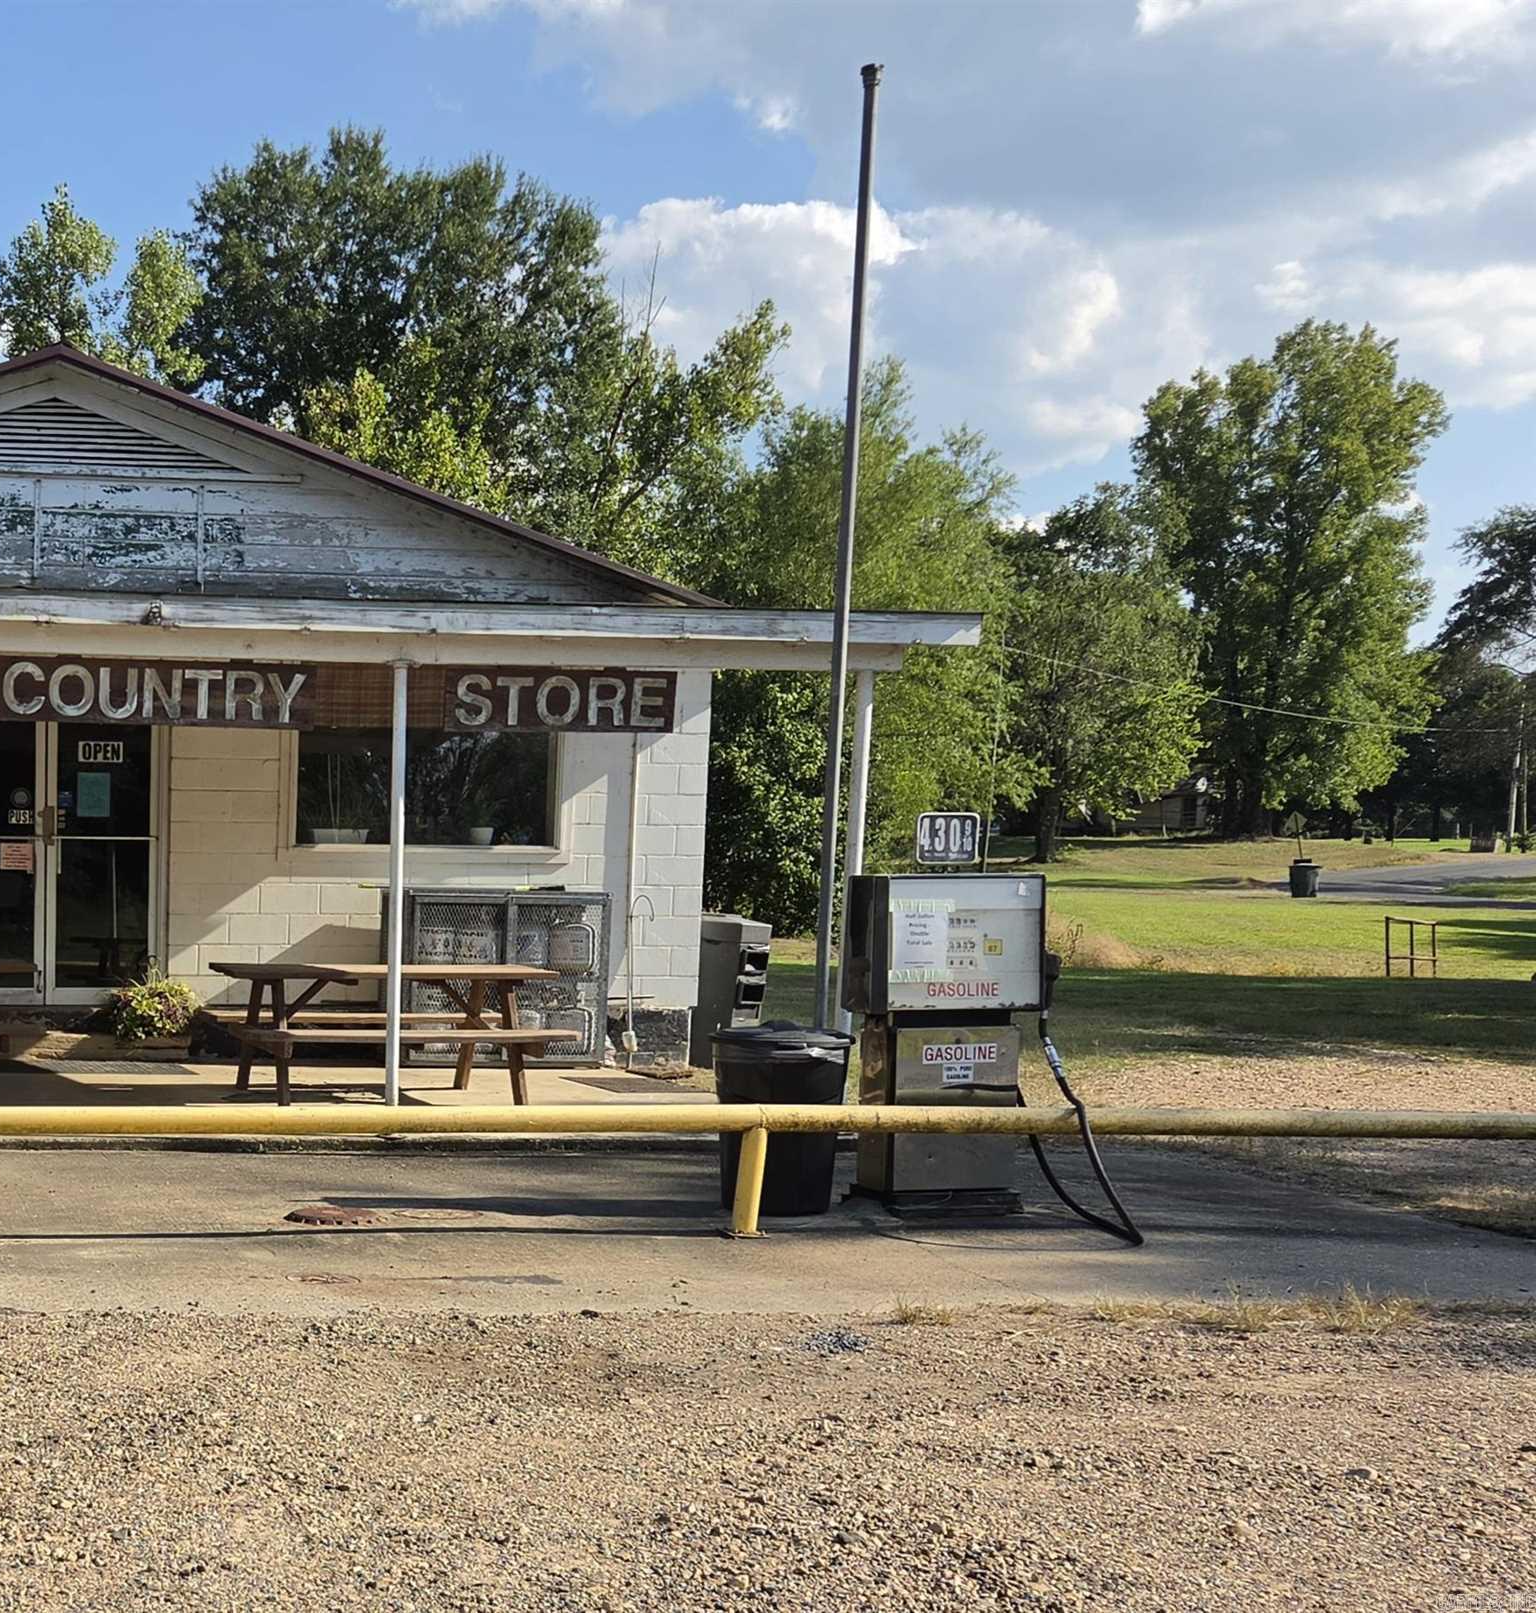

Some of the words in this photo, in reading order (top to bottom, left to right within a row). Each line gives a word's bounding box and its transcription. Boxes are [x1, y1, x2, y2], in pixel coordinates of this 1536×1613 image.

[2, 661, 308, 724] COUNTRY
[455, 674, 668, 727] STORE
[81, 742, 121, 761] OPEN
[927, 982, 1000, 998] GASOLINE
[924, 1045, 997, 1063] GASOLINE
